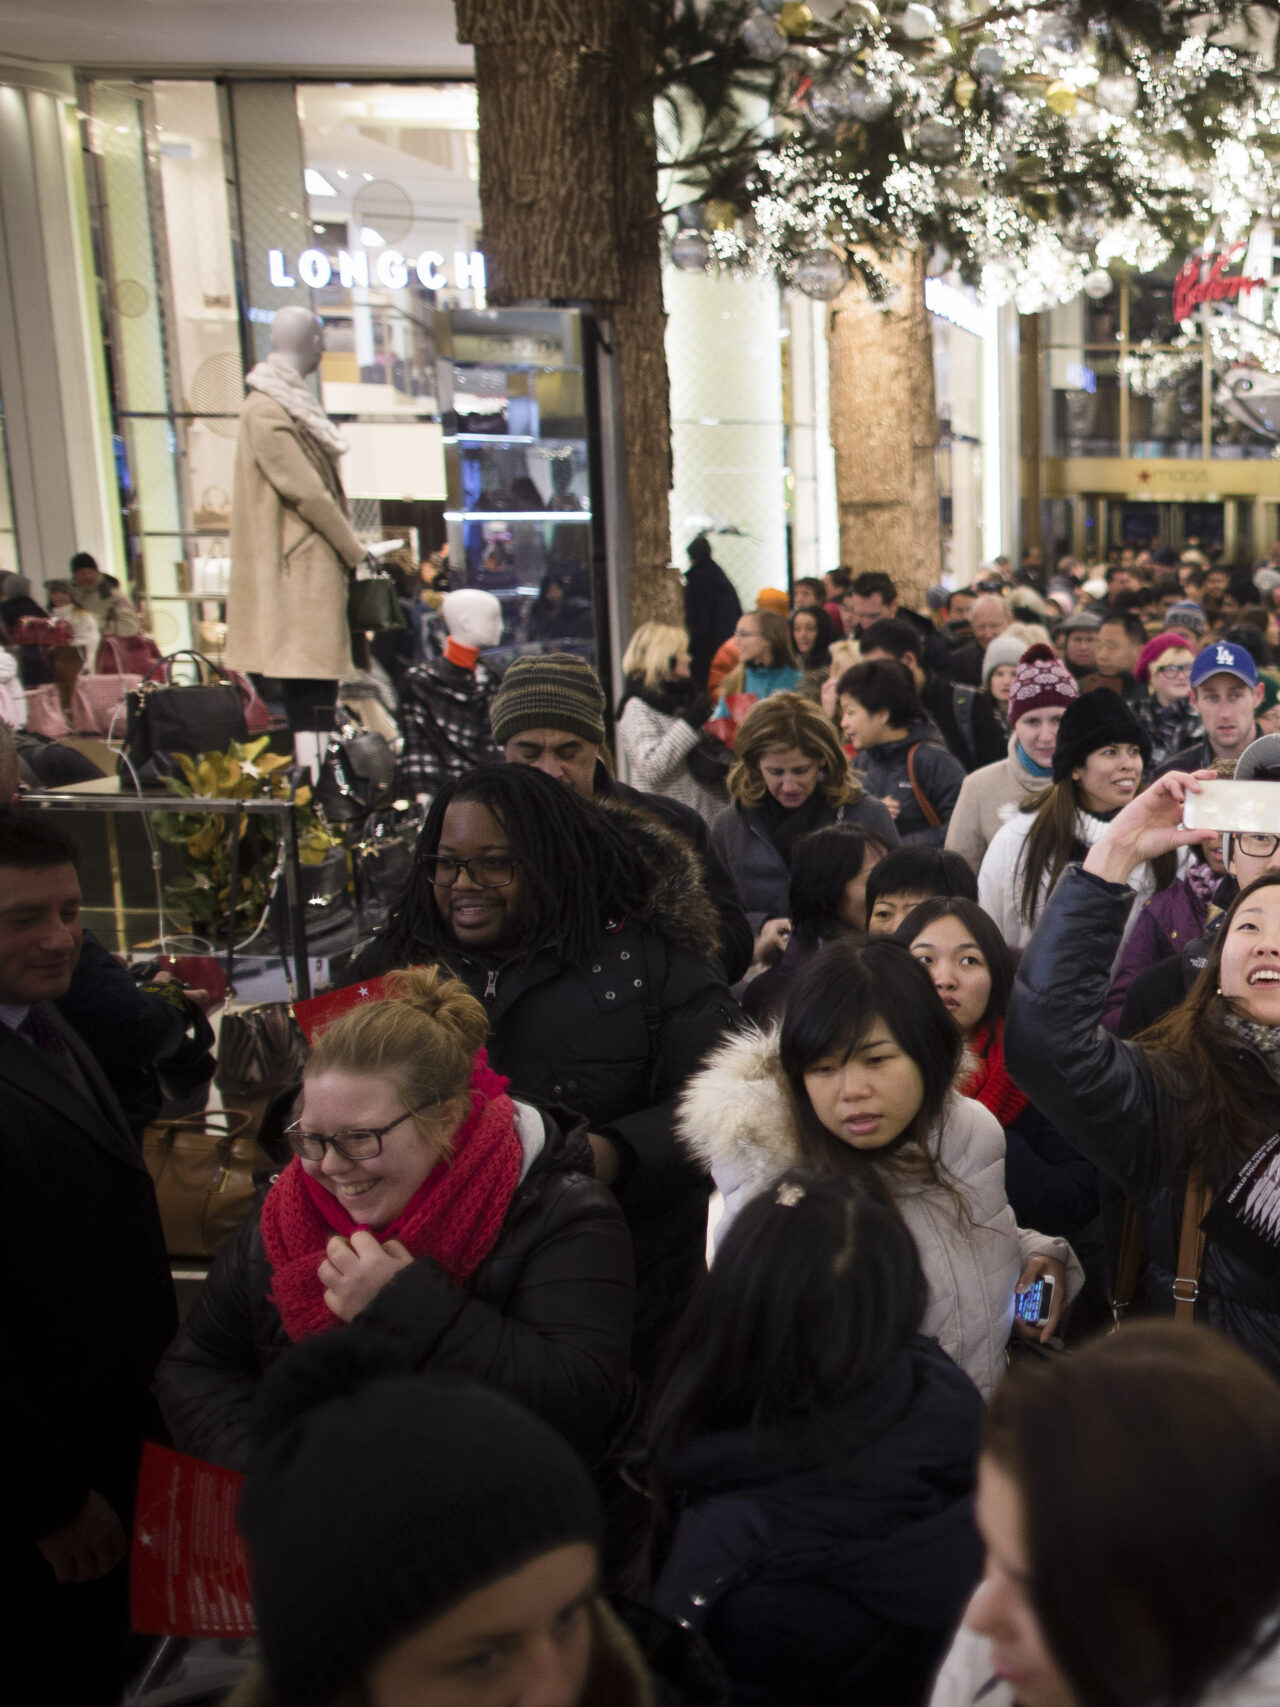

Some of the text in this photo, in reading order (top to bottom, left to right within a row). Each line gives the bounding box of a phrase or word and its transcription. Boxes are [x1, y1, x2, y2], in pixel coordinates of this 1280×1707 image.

[1216, 646, 1235, 666] LA
[1238, 1133, 1279, 1177] FIND YOUR WAY
[1226, 1176, 1248, 1203] HERALD
[1245, 1152, 1267, 1176] SQUARE
